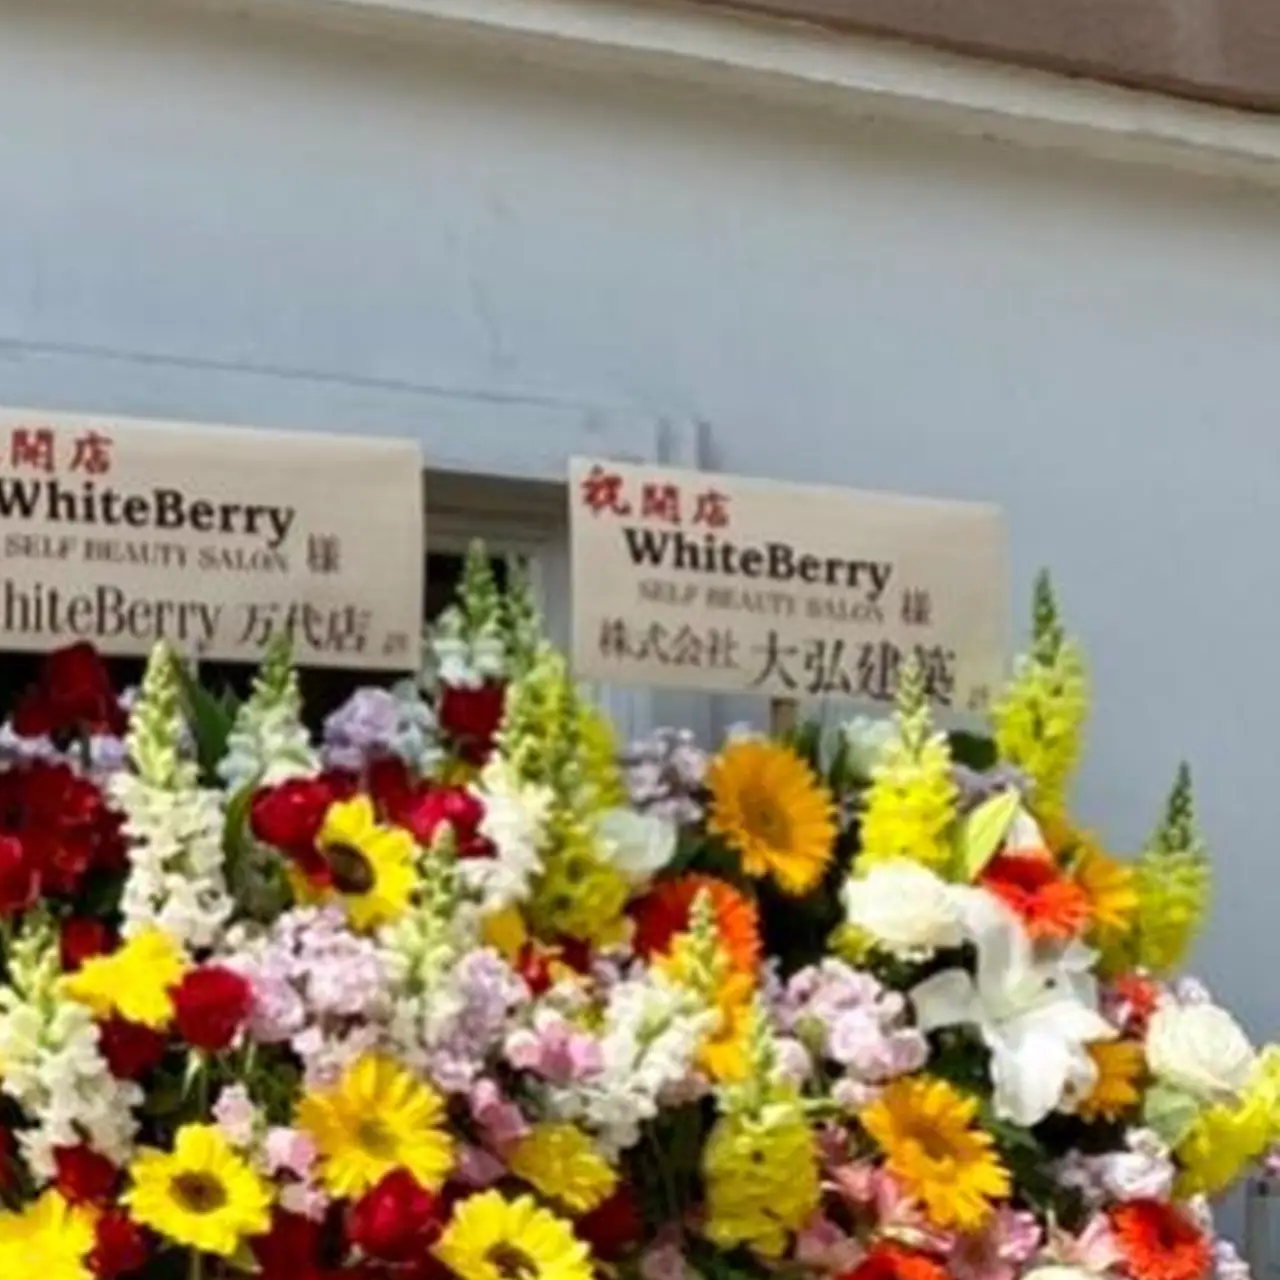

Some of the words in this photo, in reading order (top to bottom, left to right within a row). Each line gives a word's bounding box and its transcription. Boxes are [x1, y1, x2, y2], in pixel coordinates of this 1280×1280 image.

[4, 532, 77, 560] SELF
[83, 538, 188, 570] BEAUTY
[198, 545, 290, 574] SALON
[622, 527, 893, 601] WhiteBerry
[639, 579, 696, 607] SELF
[597, 617, 740, 671] 株式会社
